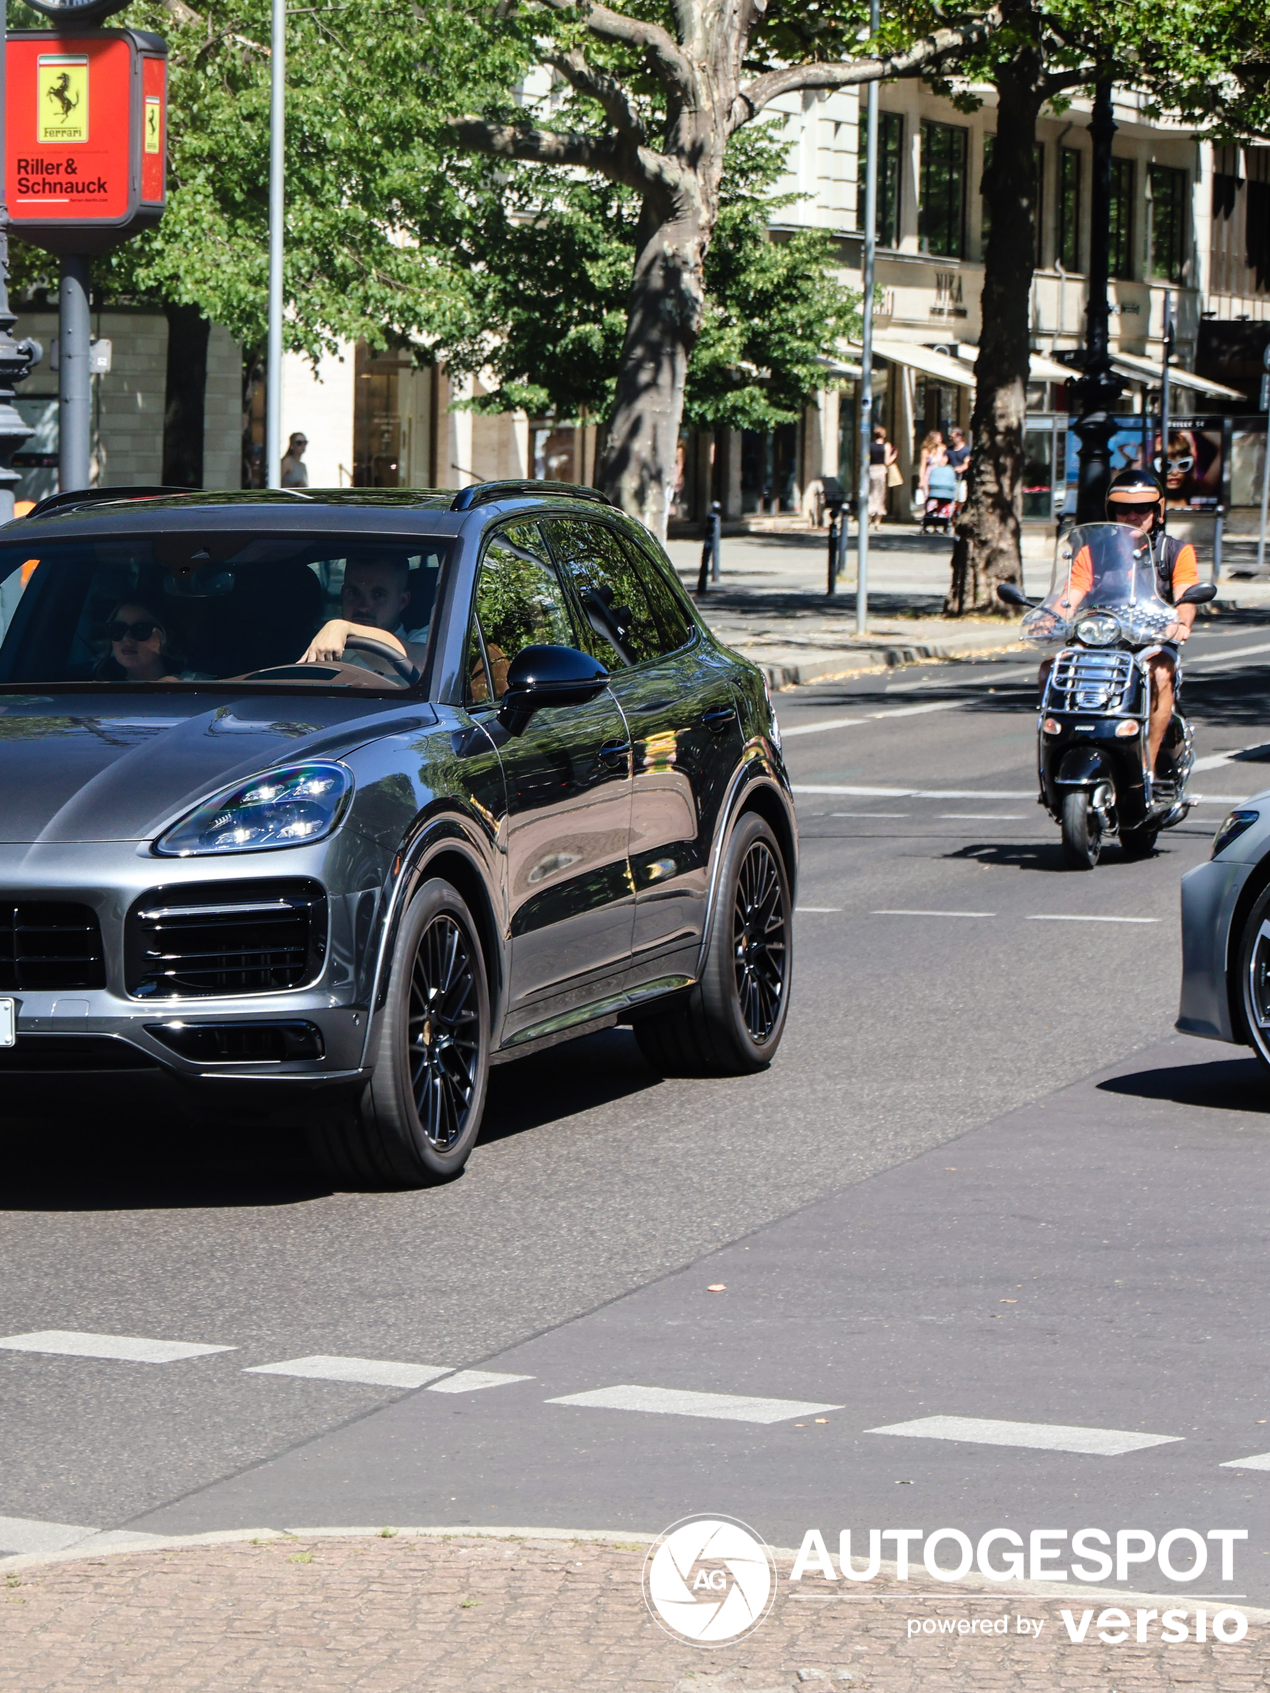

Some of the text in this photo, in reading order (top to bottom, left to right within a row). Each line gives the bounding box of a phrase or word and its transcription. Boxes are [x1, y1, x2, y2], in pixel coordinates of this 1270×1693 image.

[44, 127, 82, 138] Ferrari
[17, 177, 108, 194] Schnauck
[936, 273, 963, 303] NIKA
